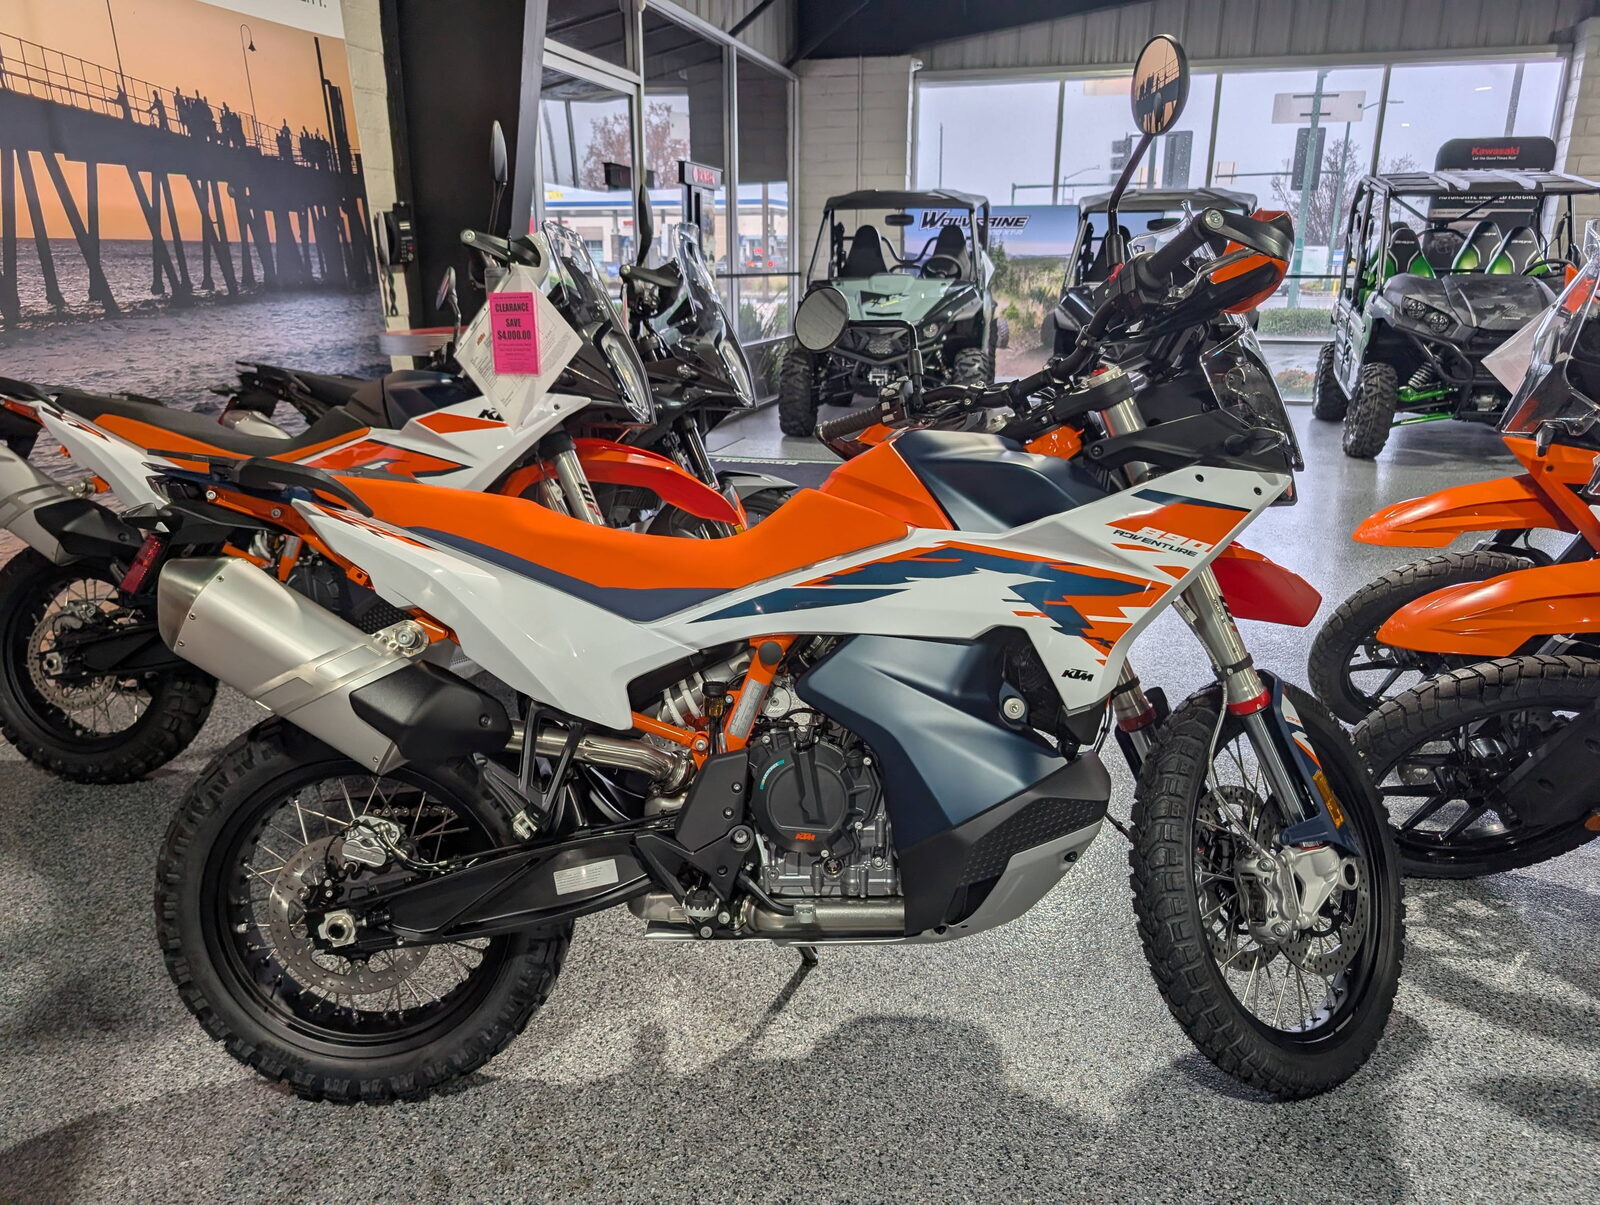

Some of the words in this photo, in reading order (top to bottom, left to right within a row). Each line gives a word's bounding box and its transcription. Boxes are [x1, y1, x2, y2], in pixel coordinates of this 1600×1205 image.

[1471, 147, 1520, 155] Kawasaki
[495, 302, 529, 313] CLEARANCE
[505, 318, 522, 328] SAVE
[1113, 529, 1199, 558] ADVENTURE
[1136, 526, 1214, 553] 890
[1061, 668, 1095, 682] KTM
[795, 833, 816, 841] KTM
